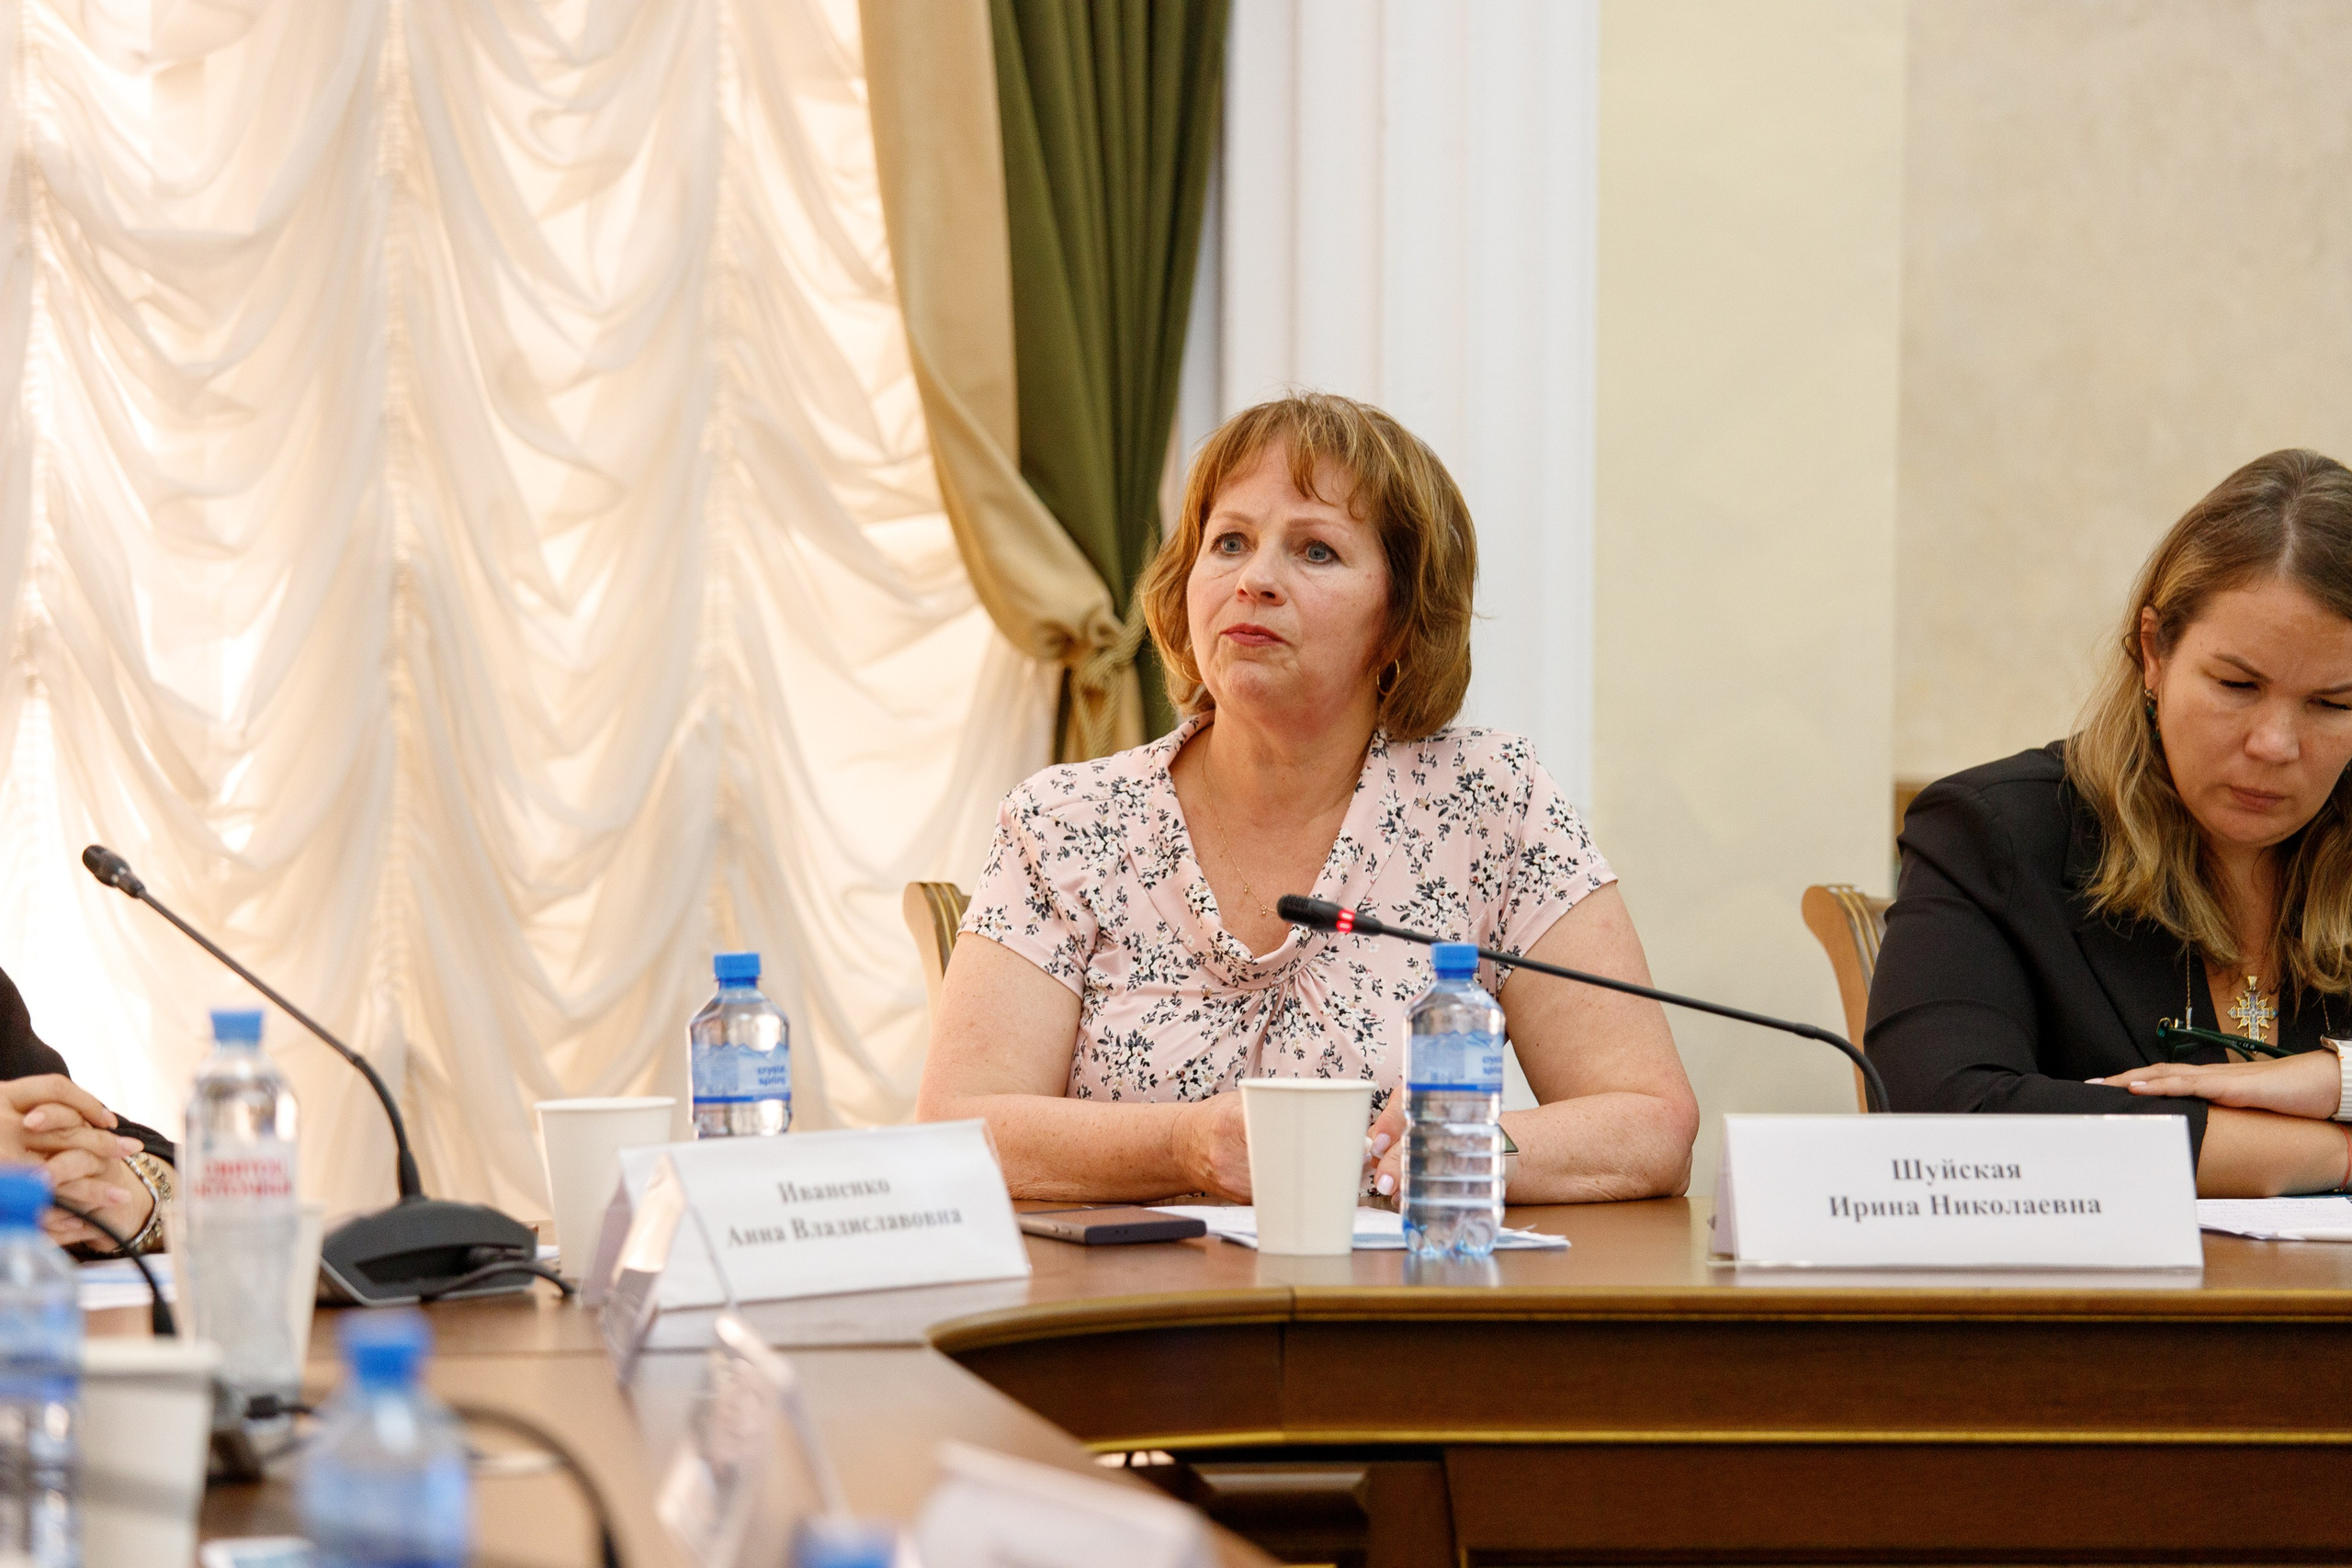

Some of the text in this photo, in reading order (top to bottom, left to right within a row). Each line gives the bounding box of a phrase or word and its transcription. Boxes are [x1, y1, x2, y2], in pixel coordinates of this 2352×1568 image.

[1892, 1158, 2022, 1185] Шуйская
[777, 1178, 890, 1203] Иваненко
[1829, 1194, 2102, 1222] Ирина Николаевна
[727, 1206, 963, 1247] Анна Владиславовна
